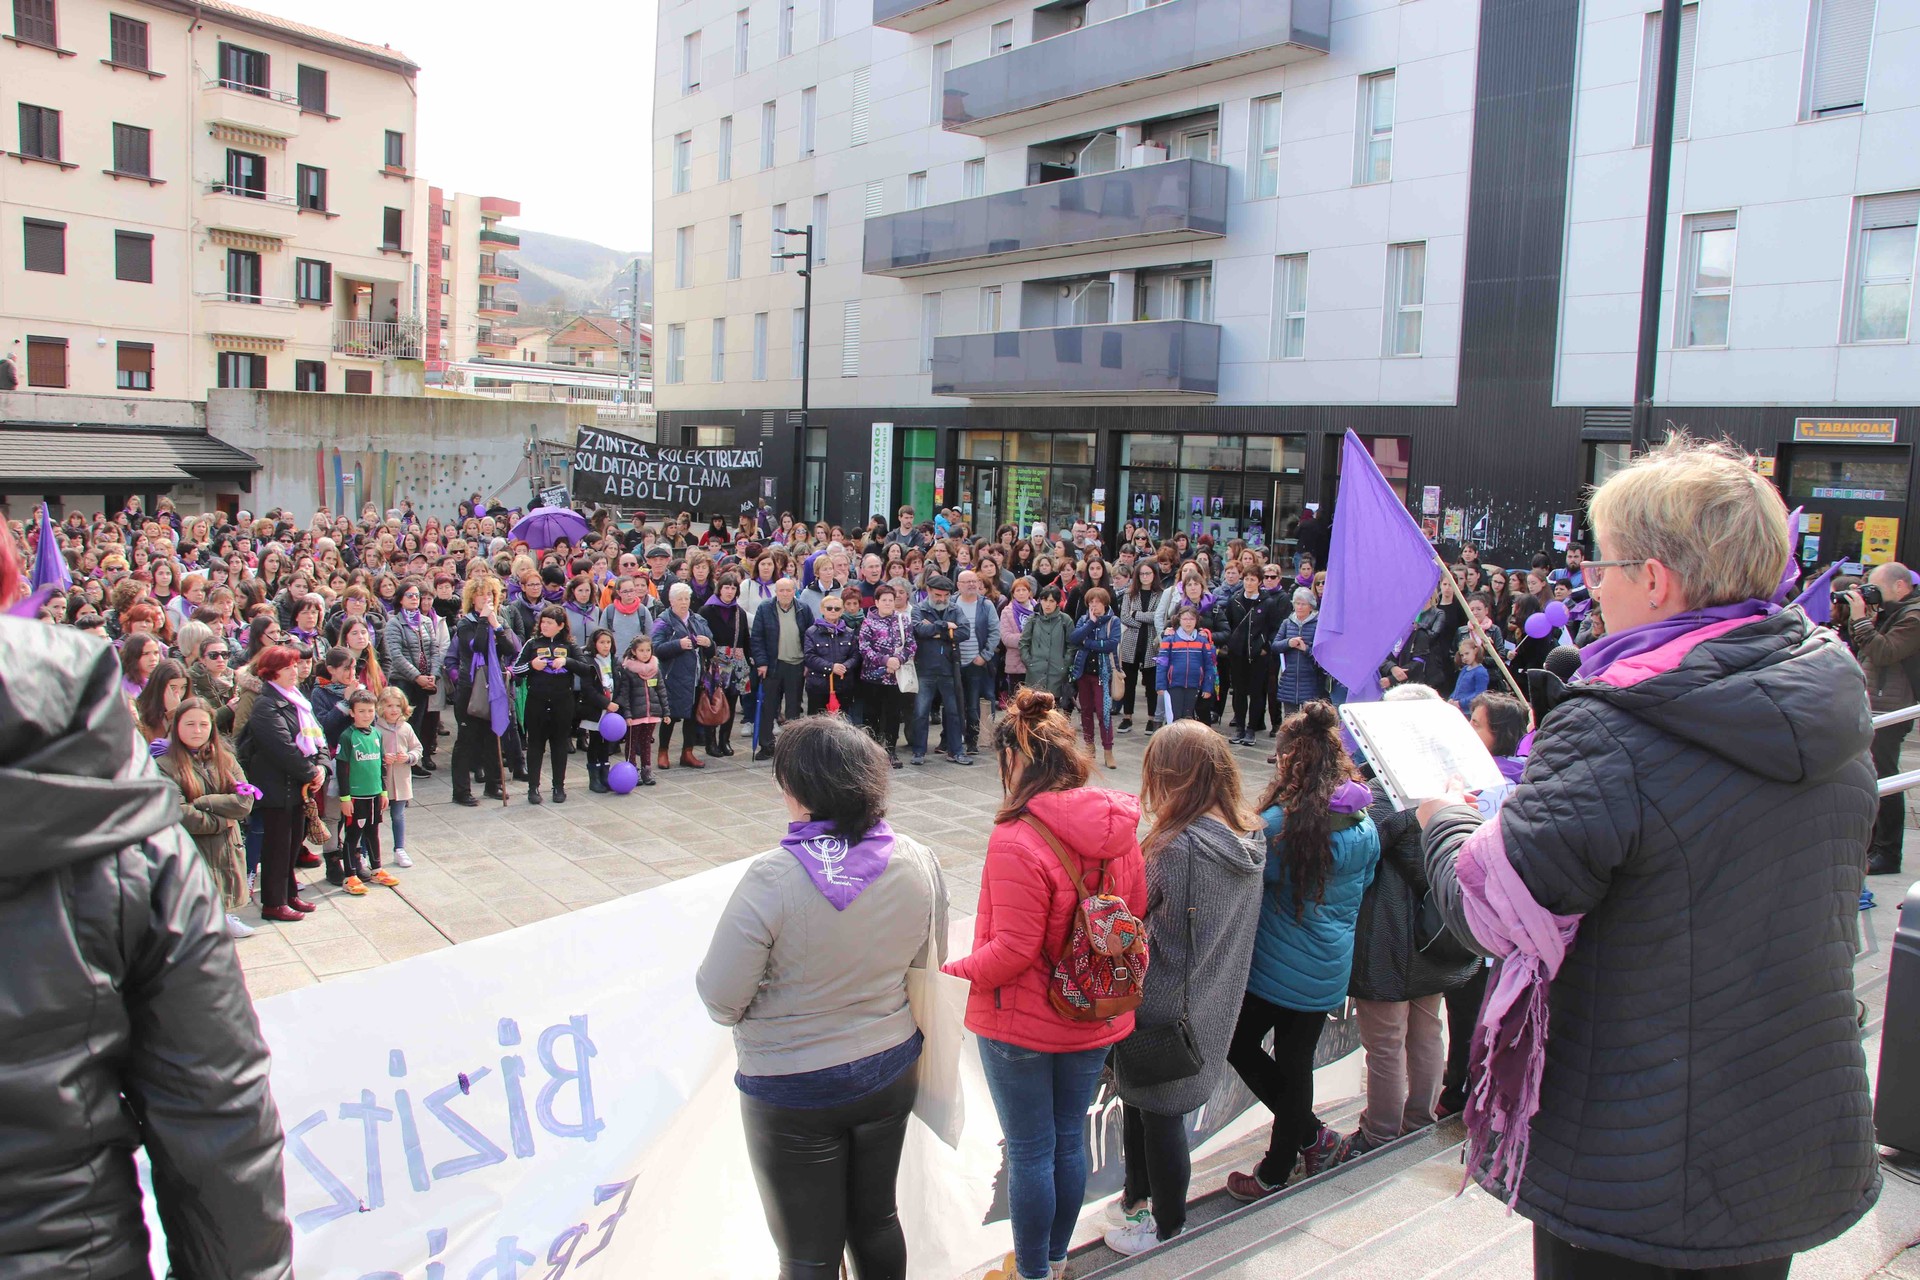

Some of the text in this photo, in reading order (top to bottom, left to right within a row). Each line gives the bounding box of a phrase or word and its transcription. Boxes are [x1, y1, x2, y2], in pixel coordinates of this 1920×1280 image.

[1817, 423, 1891, 433] TABAKOAK
[580, 431, 763, 469] ZAINTZA KOLEKTIBIZATU
[574, 453, 731, 488] SOLDATAPEKO LANA
[604, 475, 701, 507] ABOLITU
